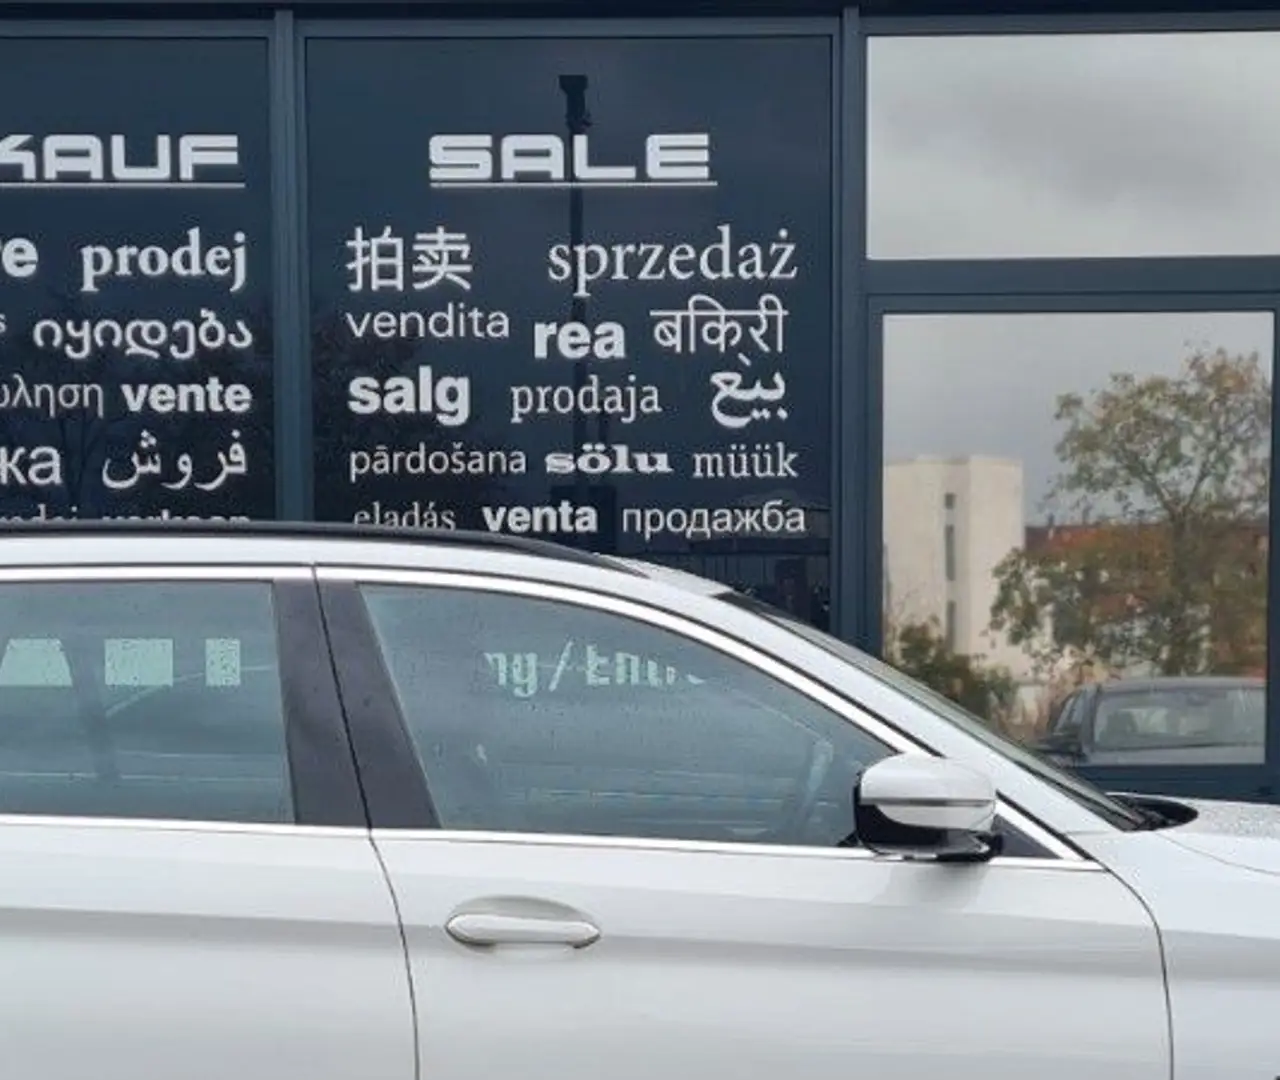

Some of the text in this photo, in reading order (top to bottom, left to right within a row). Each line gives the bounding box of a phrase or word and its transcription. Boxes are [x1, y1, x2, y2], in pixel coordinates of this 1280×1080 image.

[429, 133, 709, 180] SALE
[81, 227, 245, 292] prodej
[346, 226, 472, 291] 拍卖
[549, 224, 797, 296] sprzedaż
[34, 309, 252, 359] იყიდება
[346, 302, 626, 359] vendita rea
[122, 377, 251, 412] vente
[349, 366, 662, 425] salg prodaja
[709, 370, 788, 428] بيع
[103, 430, 246, 490] فروش
[351, 442, 797, 482] pārdošana sölu müük
[354, 501, 597, 535] eladás venta
[623, 500, 805, 540] продажба
